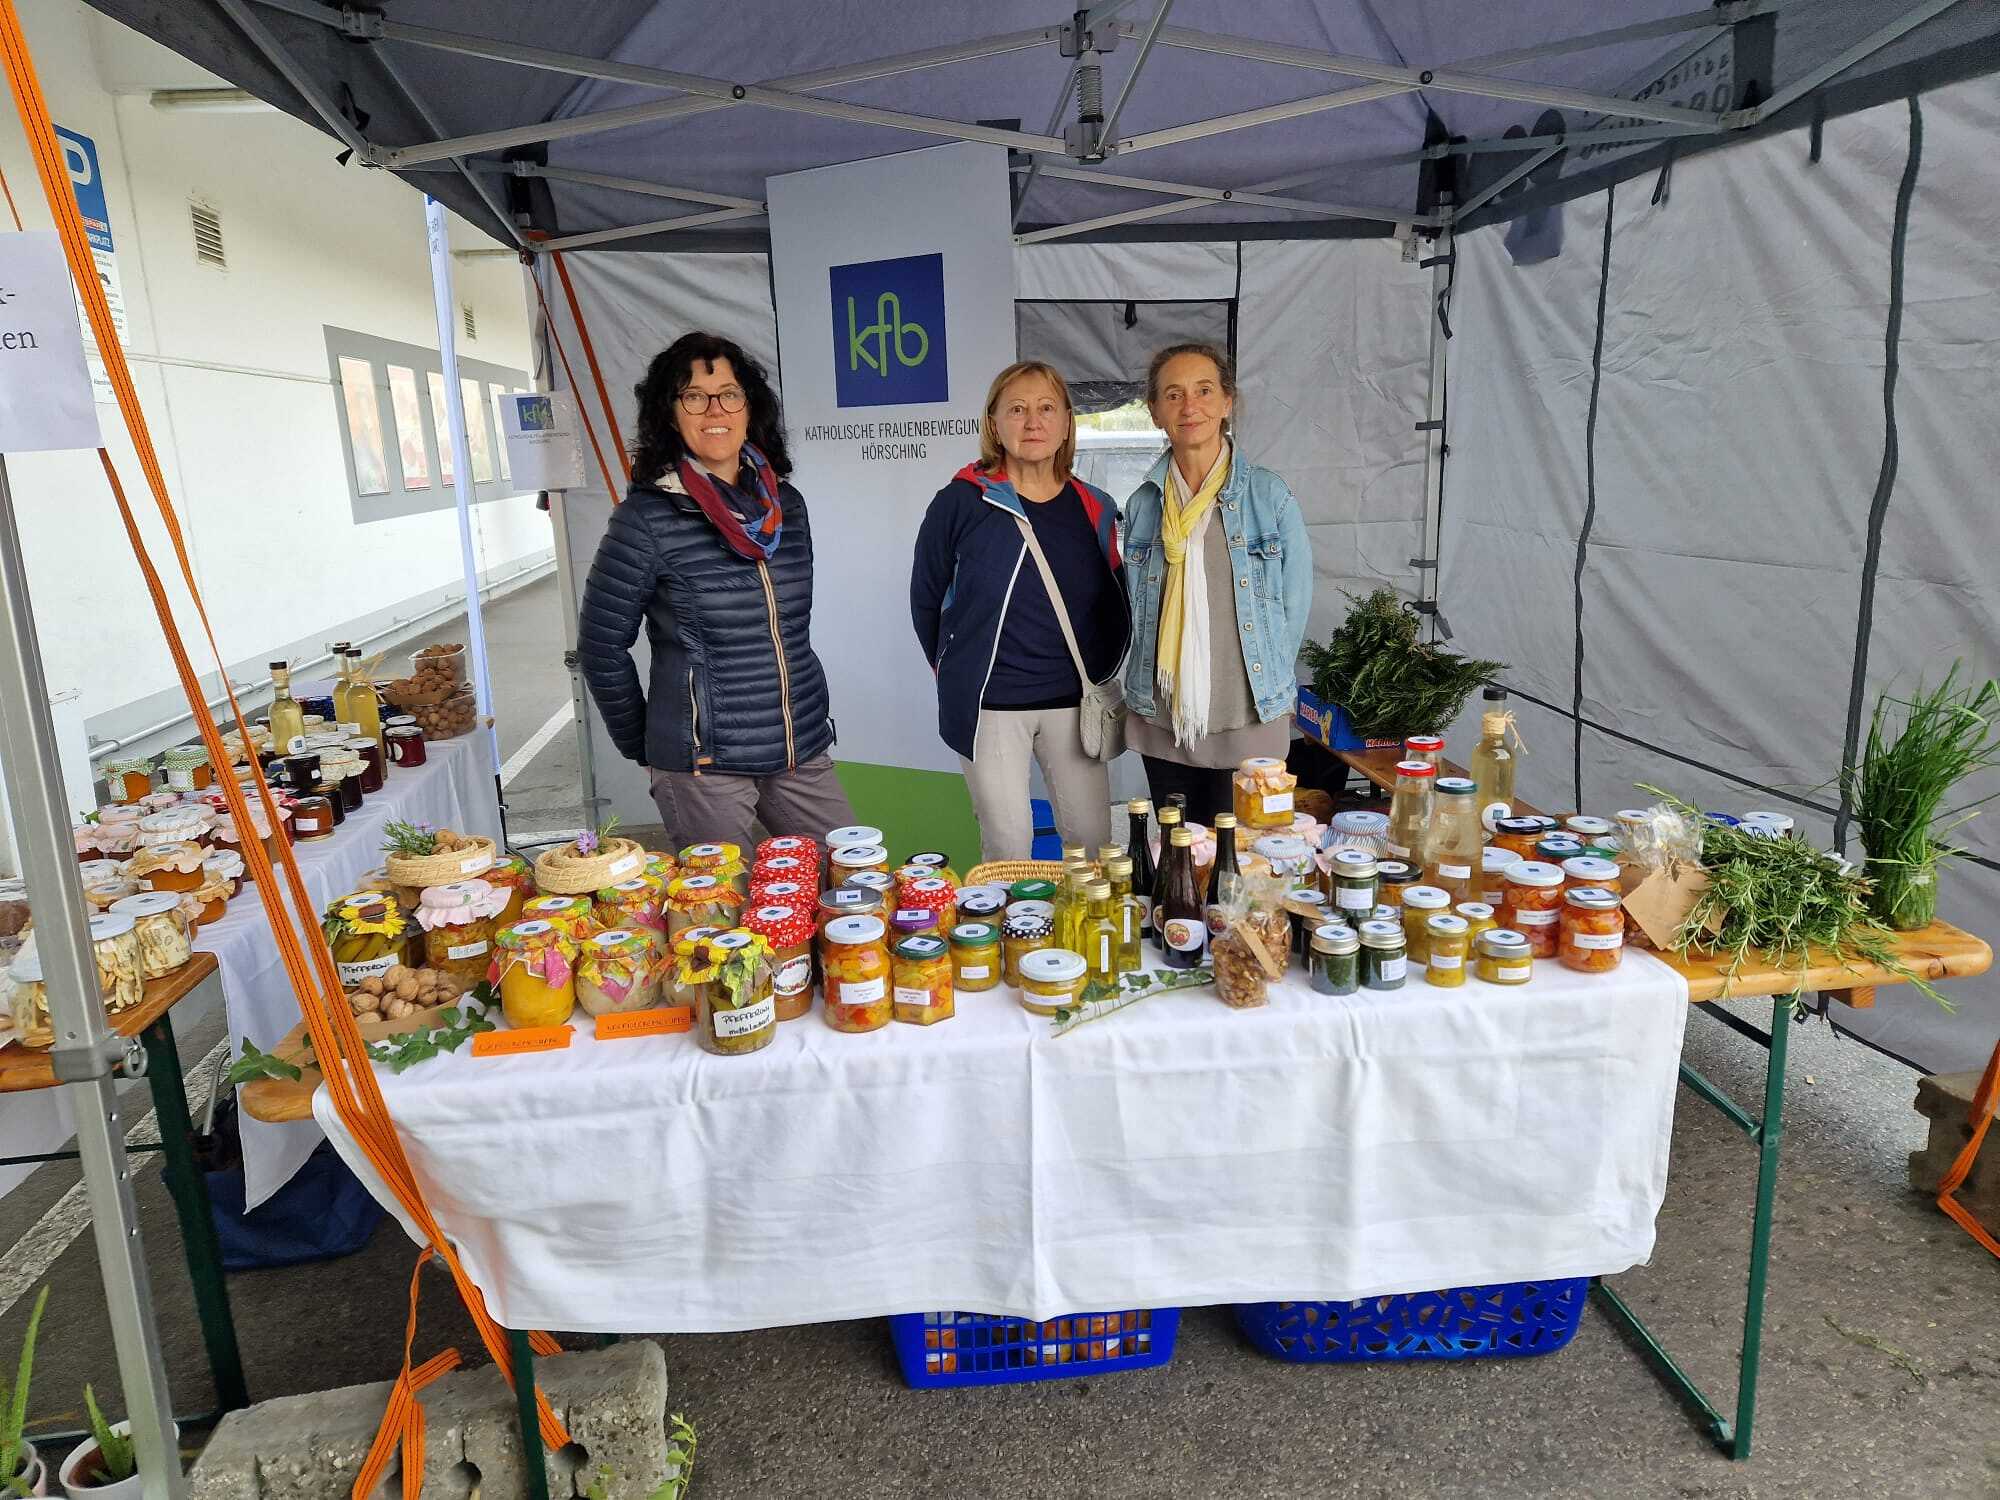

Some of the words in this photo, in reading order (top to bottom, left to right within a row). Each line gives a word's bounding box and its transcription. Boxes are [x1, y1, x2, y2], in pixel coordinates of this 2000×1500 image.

[0, 331, 39, 350] en
[848, 292, 929, 377] kfb
[804, 423, 875, 441] KATHOLISCHE
[878, 418, 980, 438] FRAUENBEWEGUN
[861, 441, 927, 461] HÖRSCHING
